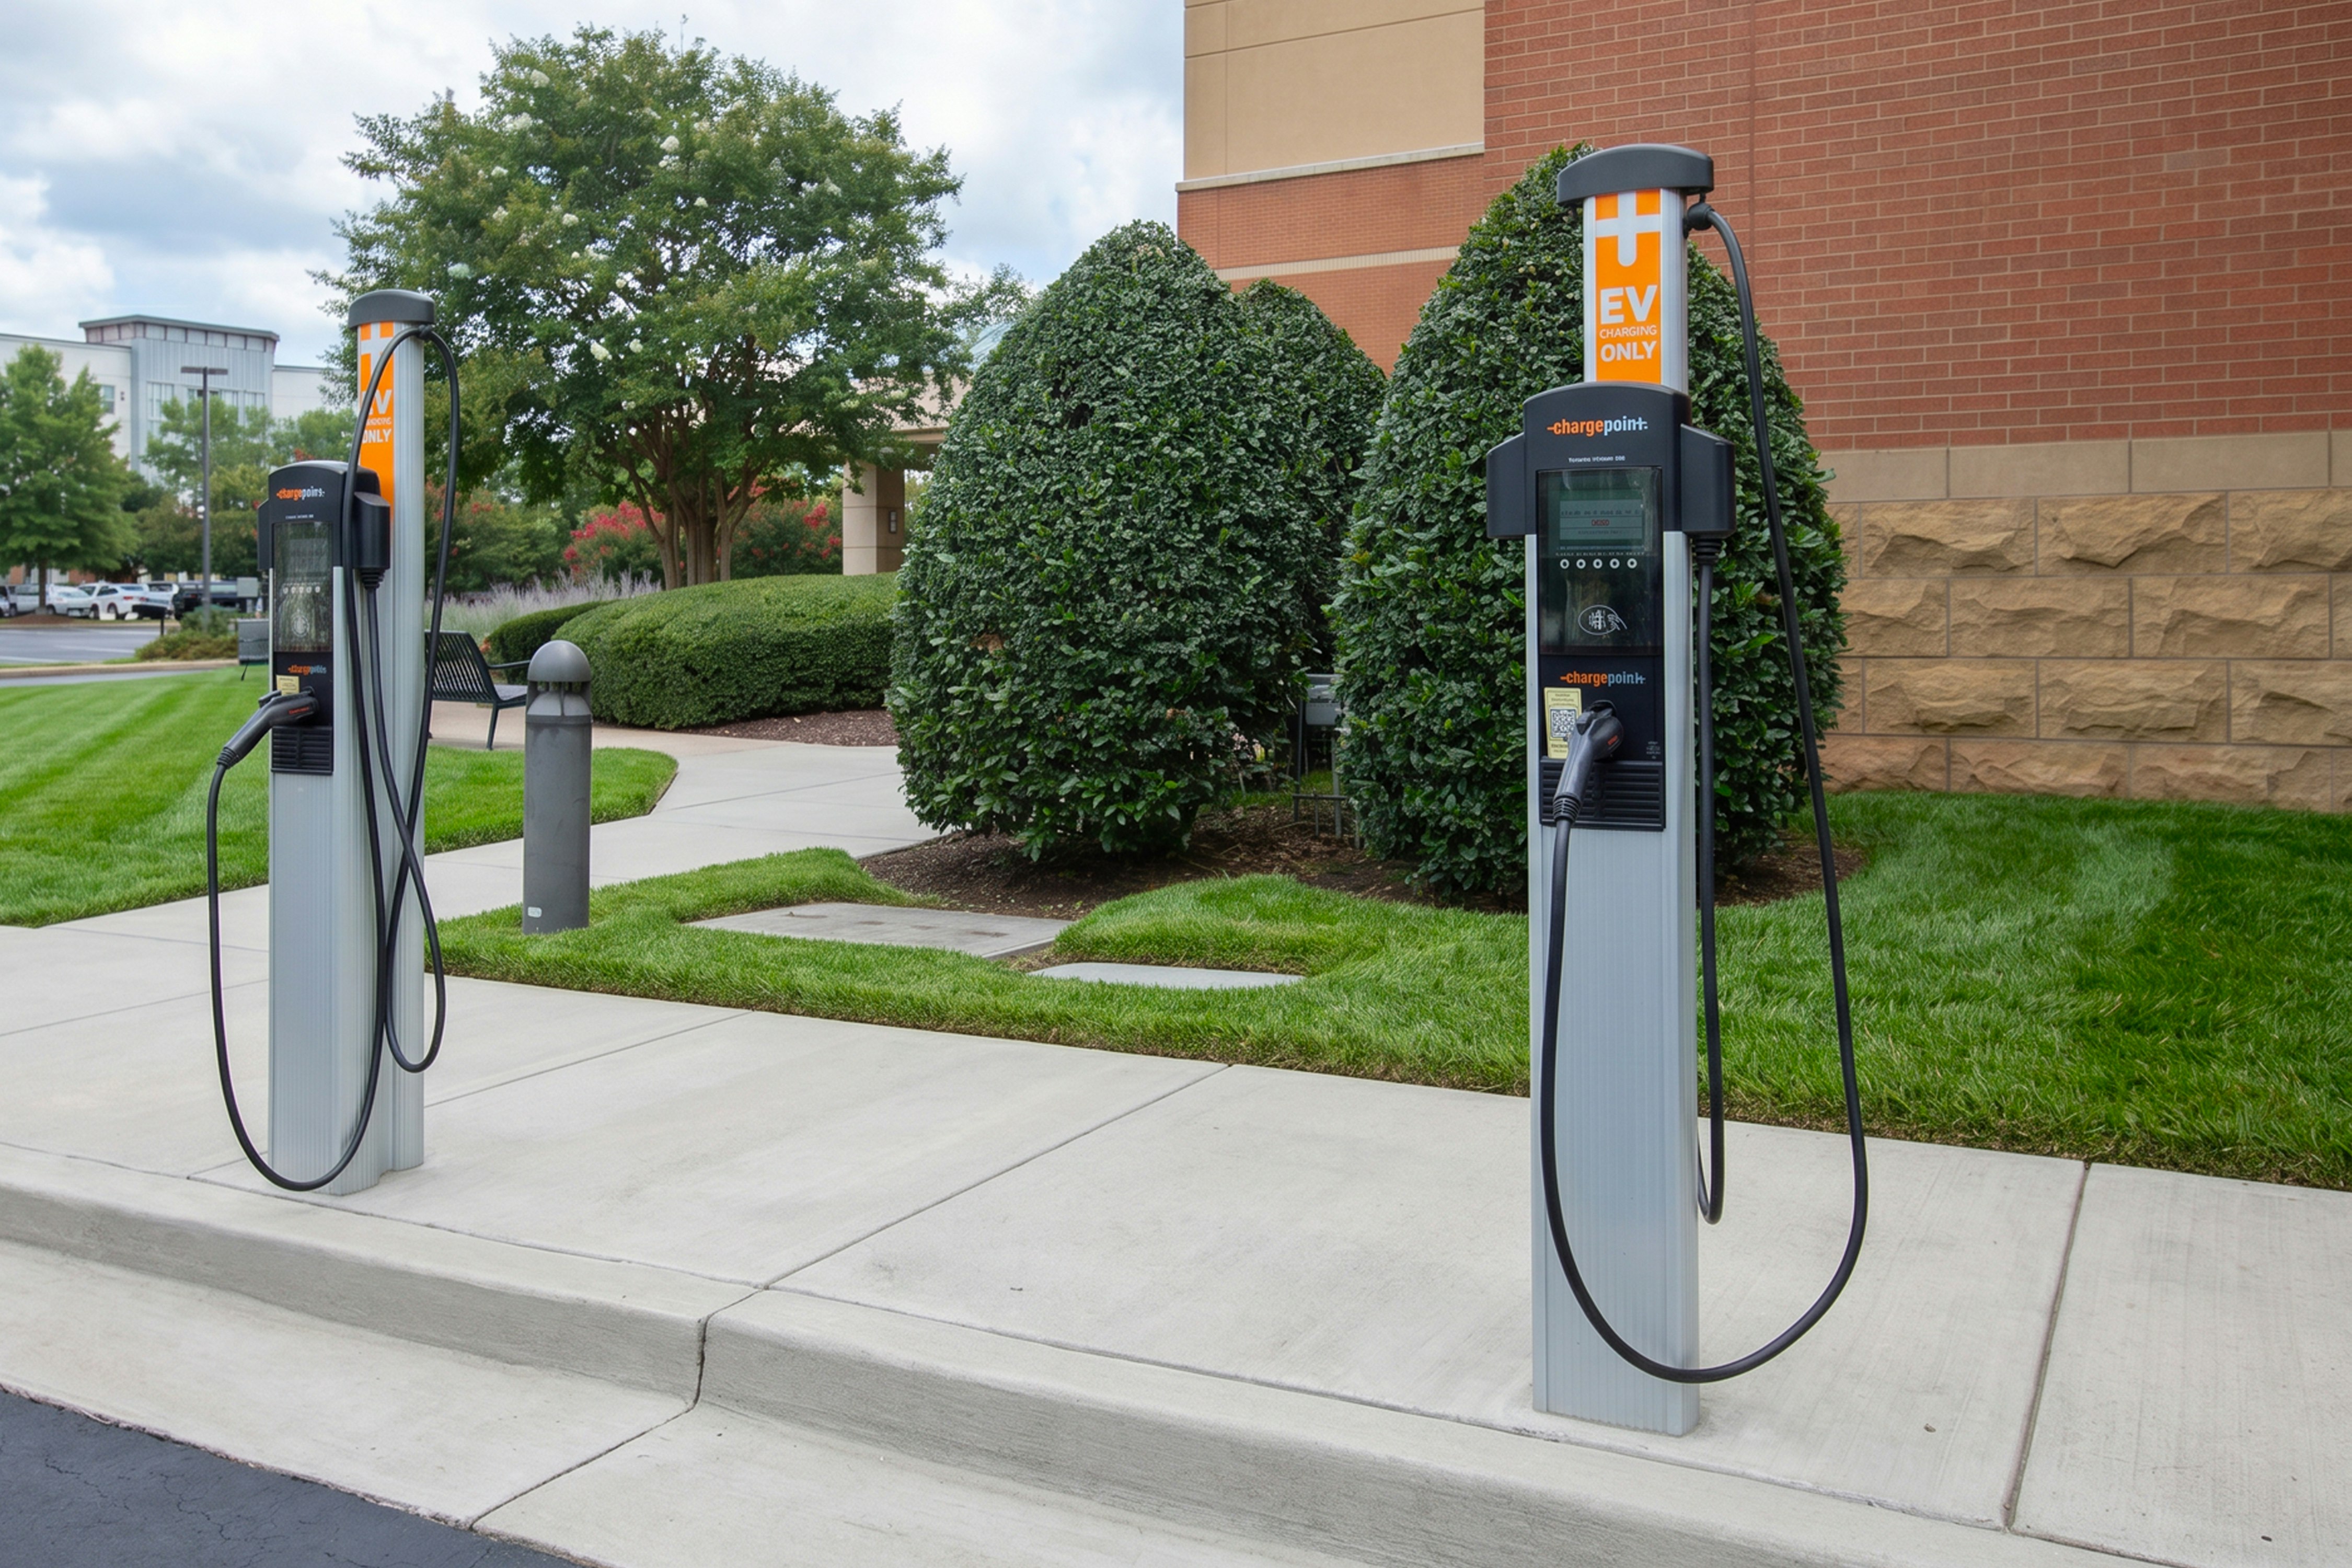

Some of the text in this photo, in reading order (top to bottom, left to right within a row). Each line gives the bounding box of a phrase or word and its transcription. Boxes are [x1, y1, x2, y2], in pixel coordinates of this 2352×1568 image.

[1600, 284, 1658, 325] EV
[1599, 325, 1657, 339] CHARGING
[1600, 341, 1657, 362] ONLY
[362, 389, 392, 415] V
[1547, 416, 1648, 436] chargepoint
[1560, 671, 1646, 687] chargepoint
